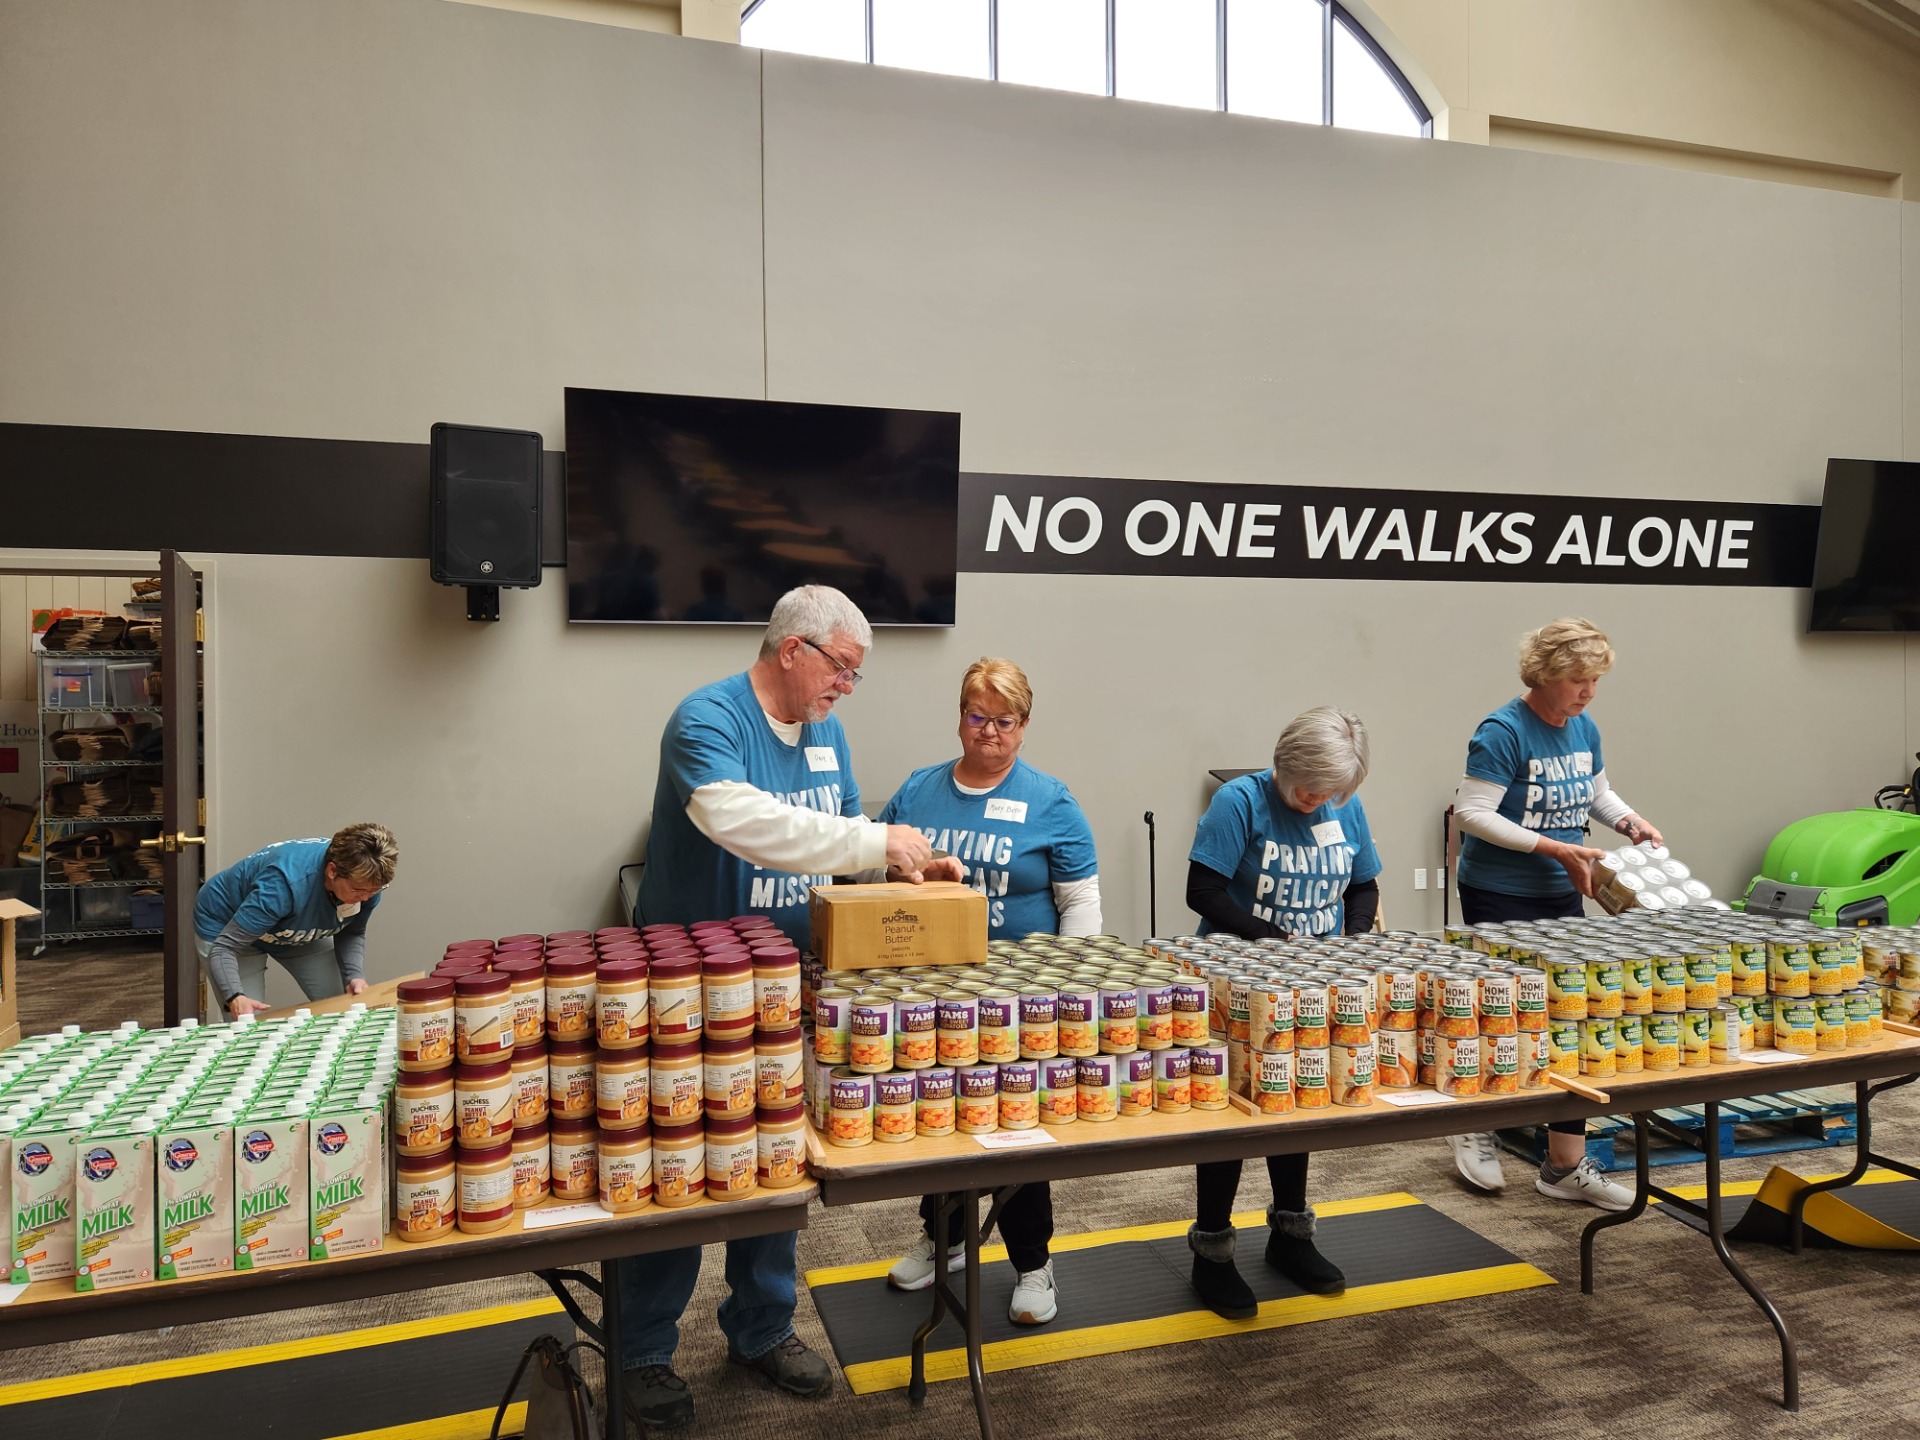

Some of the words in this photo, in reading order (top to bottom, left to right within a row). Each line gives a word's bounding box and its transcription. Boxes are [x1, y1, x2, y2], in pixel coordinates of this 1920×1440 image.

[985, 494, 1103, 554] NO
[1124, 499, 1282, 558] ONE
[1302, 505, 1535, 564] WALKS
[1546, 514, 1754, 569] ALONE
[882, 914, 918, 924] DUCHESS
[885, 925, 915, 934] Peanut
[885, 935, 913, 944] Butter
[1393, 982, 1415, 991] HOME
[1484, 986, 1510, 996] HOME
[1520, 982, 1545, 991] HOME
[1393, 990, 1415, 999] STYLE
[1445, 988, 1471, 997] HOME
[1520, 991, 1545, 1000] STYLE
[1110, 999, 1136, 1008] YAMS
[1300, 997, 1324, 1006] HOME
[1337, 994, 1363, 1004] HOME
[1445, 997, 1471, 1006] STYLE
[1484, 995, 1510, 1005] STYLE
[562, 1001, 584, 1009] PEANUT
[1024, 1004, 1054, 1013] YAMS
[1337, 1003, 1363, 1013] STYLE
[907, 1011, 935, 1021] YAMS
[940, 1010, 968, 1019] YAMS
[1300, 1006, 1324, 1016] STYLE
[422, 1018, 448, 1028] DUCHESS
[853, 1015, 880, 1025] YAMS
[1457, 1047, 1479, 1057] HOME
[1497, 1045, 1517, 1054] HOME
[1300, 1057, 1325, 1067] HOME
[1457, 1056, 1479, 1065] STYLE
[1497, 1054, 1518, 1063] STYLE
[1262, 1061, 1288, 1072] HOME
[1300, 1066, 1325, 1076] STYLE
[567, 1071, 593, 1080] DUCHESS
[673, 1075, 698, 1085] DUCHESS
[1002, 1073, 1031, 1082] YAMS
[1262, 1071, 1288, 1081] STYLE
[924, 1079, 953, 1089] YAMS
[967, 1077, 995, 1087] YAMS
[834, 1089, 864, 1098] YAMS
[881, 1084, 912, 1094] YAMS
[463, 1098, 490, 1106] DUCHESS
[411, 1105, 440, 1114] DUCHESS
[772, 1140, 796, 1148] DUCHESS
[570, 1150, 596, 1160] DUCHESS
[513, 1159, 539, 1168] DUCHESS
[609, 1163, 636, 1171] DUCHESS
[515, 1166, 537, 1174] PEANUT
[326, 1173, 350, 1186] LOWFAT
[251, 1182, 276, 1194] LOWFAT
[175, 1190, 200, 1203] LOWFAT
[316, 1176, 363, 1211] MILK
[411, 1189, 440, 1199] DUCHESS
[29, 1193, 55, 1209] LOWFAT
[241, 1185, 289, 1219] MILK
[413, 1197, 437, 1205] PEANUT
[93, 1200, 120, 1214] LOWFAT
[164, 1193, 214, 1230] MILK
[17, 1198, 69, 1234] MILK
[81, 1204, 134, 1240] MILK
